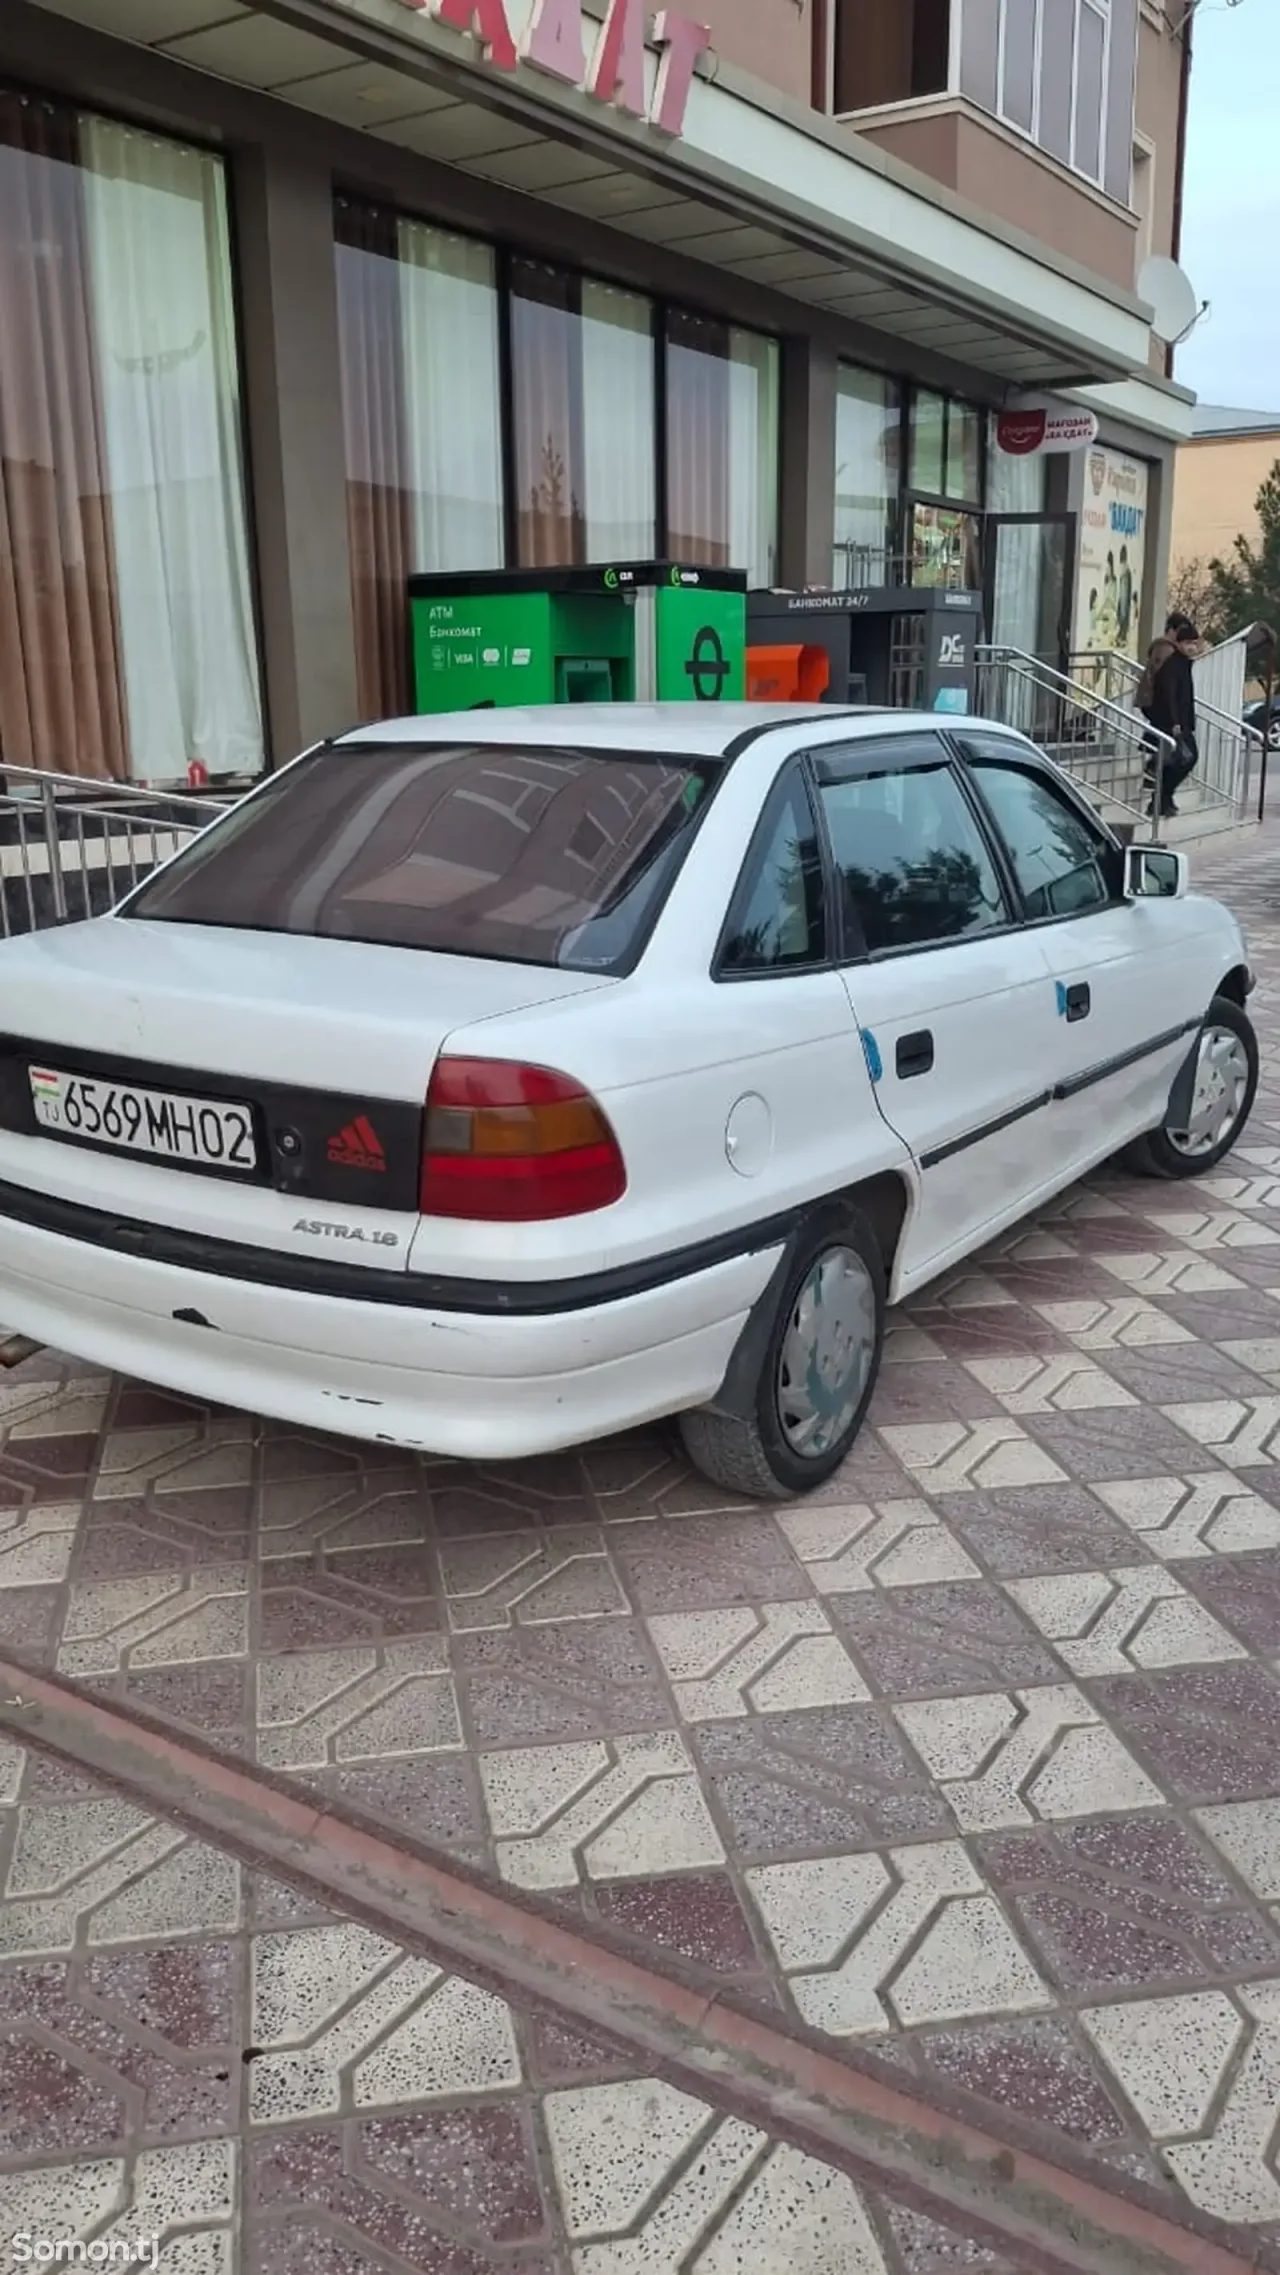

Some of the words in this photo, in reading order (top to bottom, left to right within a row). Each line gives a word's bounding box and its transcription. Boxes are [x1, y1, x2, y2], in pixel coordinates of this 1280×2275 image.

[396, 0, 711, 138] ДАТ
[788, 595, 844, 609] БАНКОМАТ
[845, 594, 869, 608] 24/7
[429, 625, 482, 638] Банкомат
[454, 653, 474, 664] VISA
[43, 1101, 60, 1123] TJ
[64, 1080, 252, 1165] 6569MH02
[327, 1149, 387, 1172] adidas
[292, 1218, 366, 1242] ASTRA
